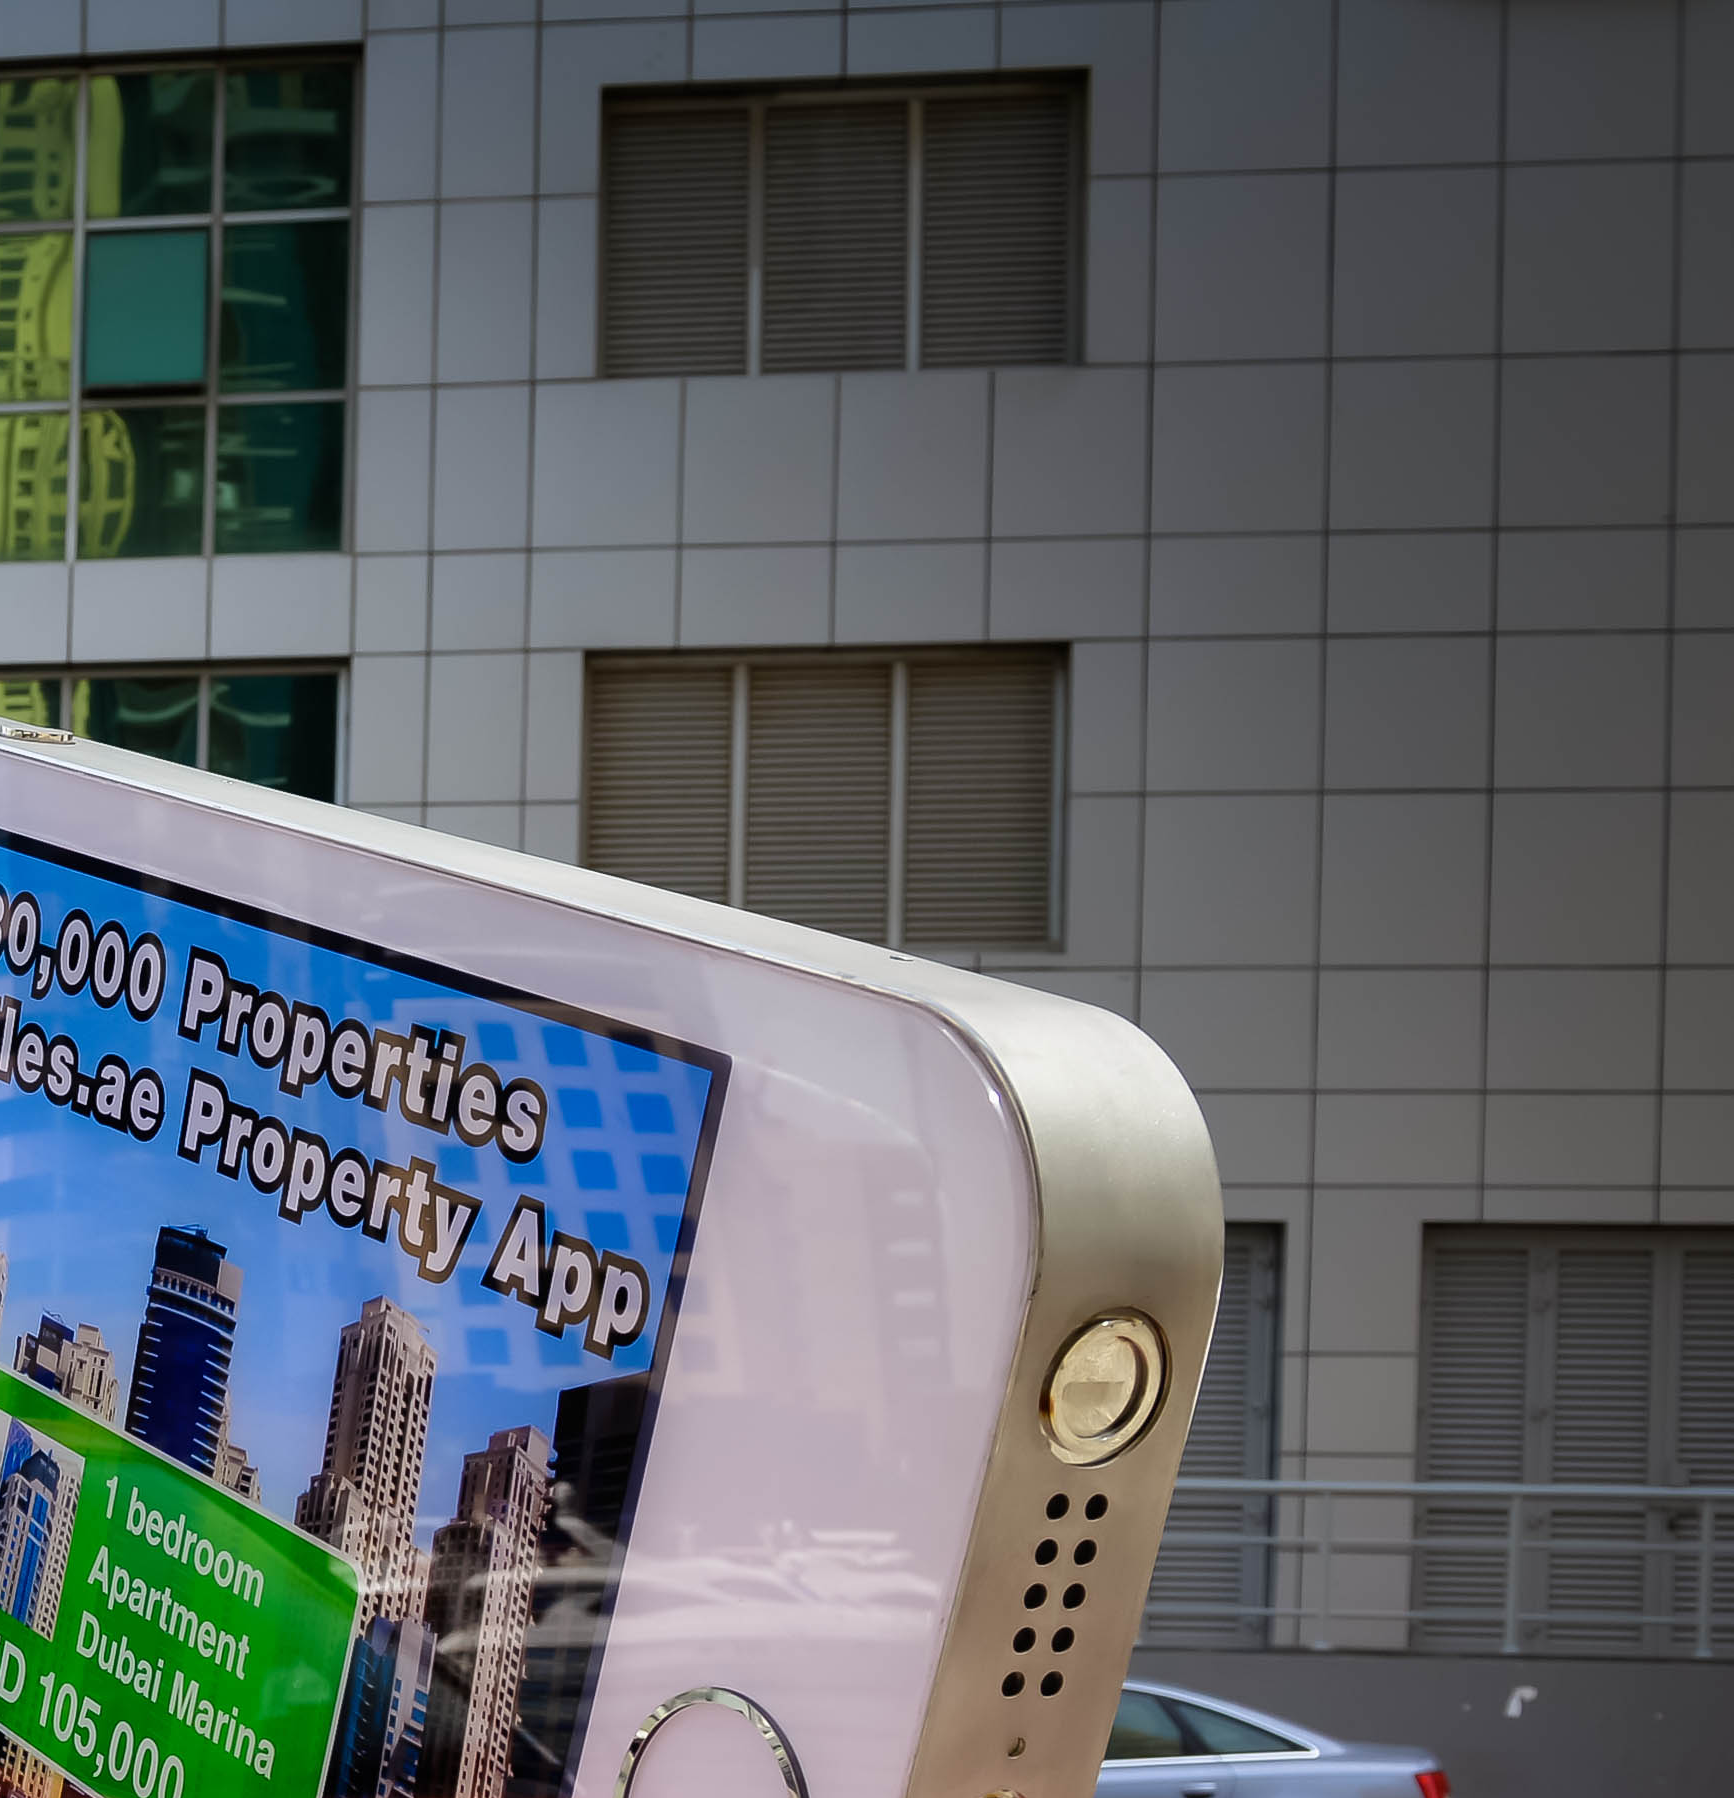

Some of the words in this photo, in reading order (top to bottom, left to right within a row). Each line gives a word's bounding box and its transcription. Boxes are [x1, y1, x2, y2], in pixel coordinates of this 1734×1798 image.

[181, 954, 543, 1156] Properties
[181, 1076, 473, 1275] Property
[490, 1206, 646, 1347] App
[87, 1544, 250, 1680] Apartment
[105, 1475, 119, 1519] 1
[125, 1486, 265, 1608] bedroom
[76, 1610, 165, 1704] Dubai
[168, 1669, 277, 1781] Marina
